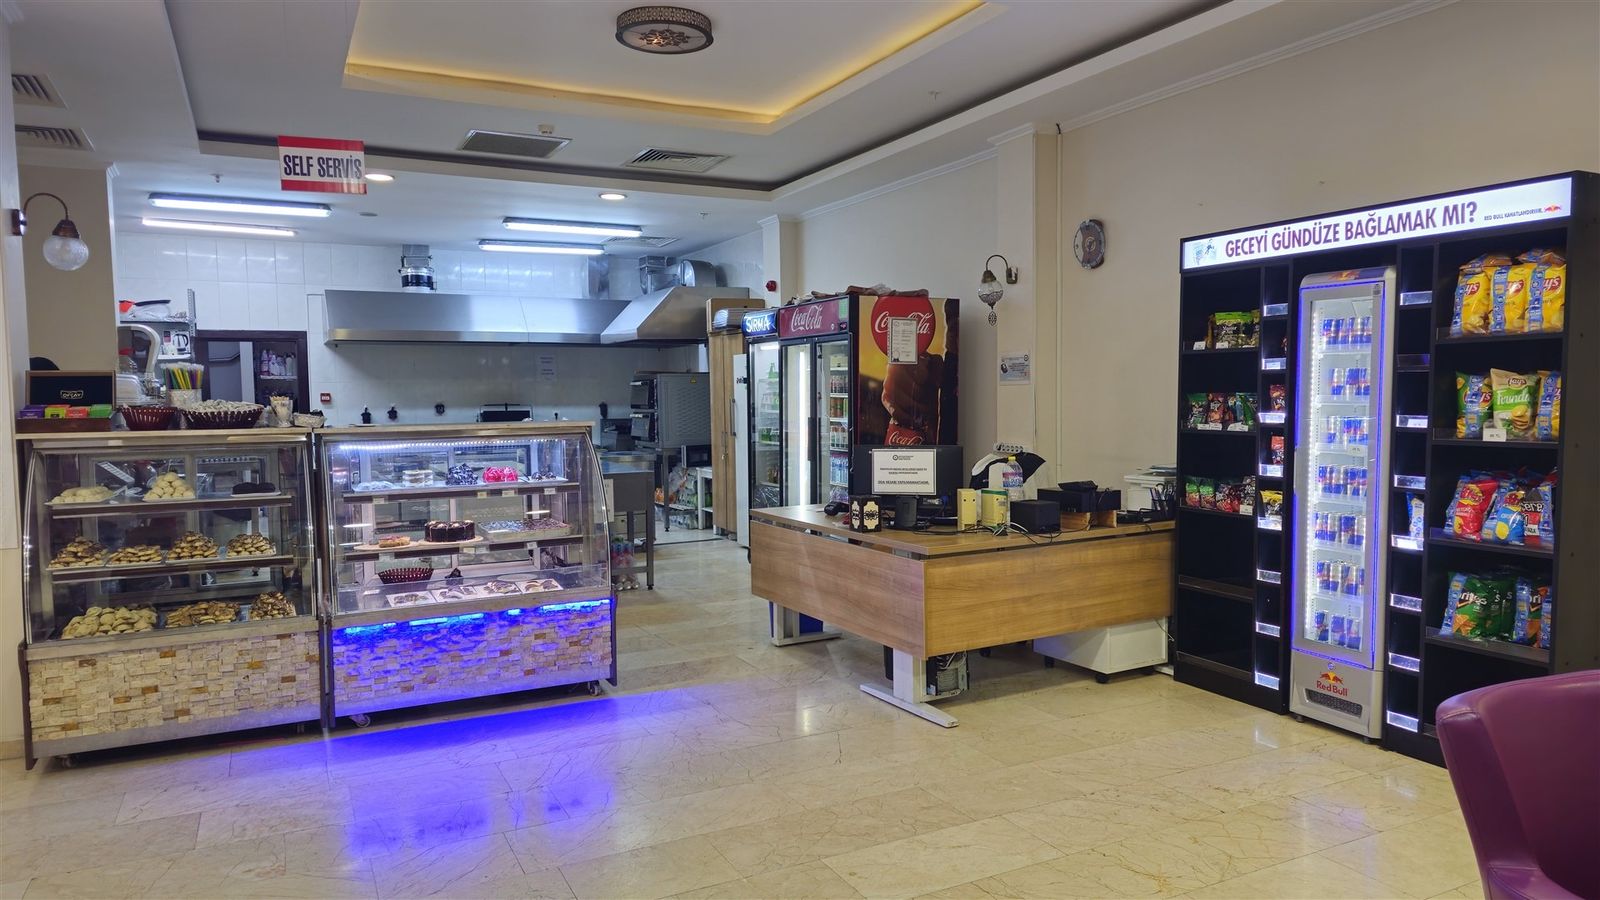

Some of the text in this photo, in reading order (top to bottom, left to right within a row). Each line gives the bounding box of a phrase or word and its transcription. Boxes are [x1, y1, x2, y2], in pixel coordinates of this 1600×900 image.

[283, 154, 362, 179] SELF SERVİS
[1225, 201, 1478, 257] GECEYİ GÜNDÜZE BAĞLAMAK MI?
[1316, 680, 1348, 697] Red Bull
